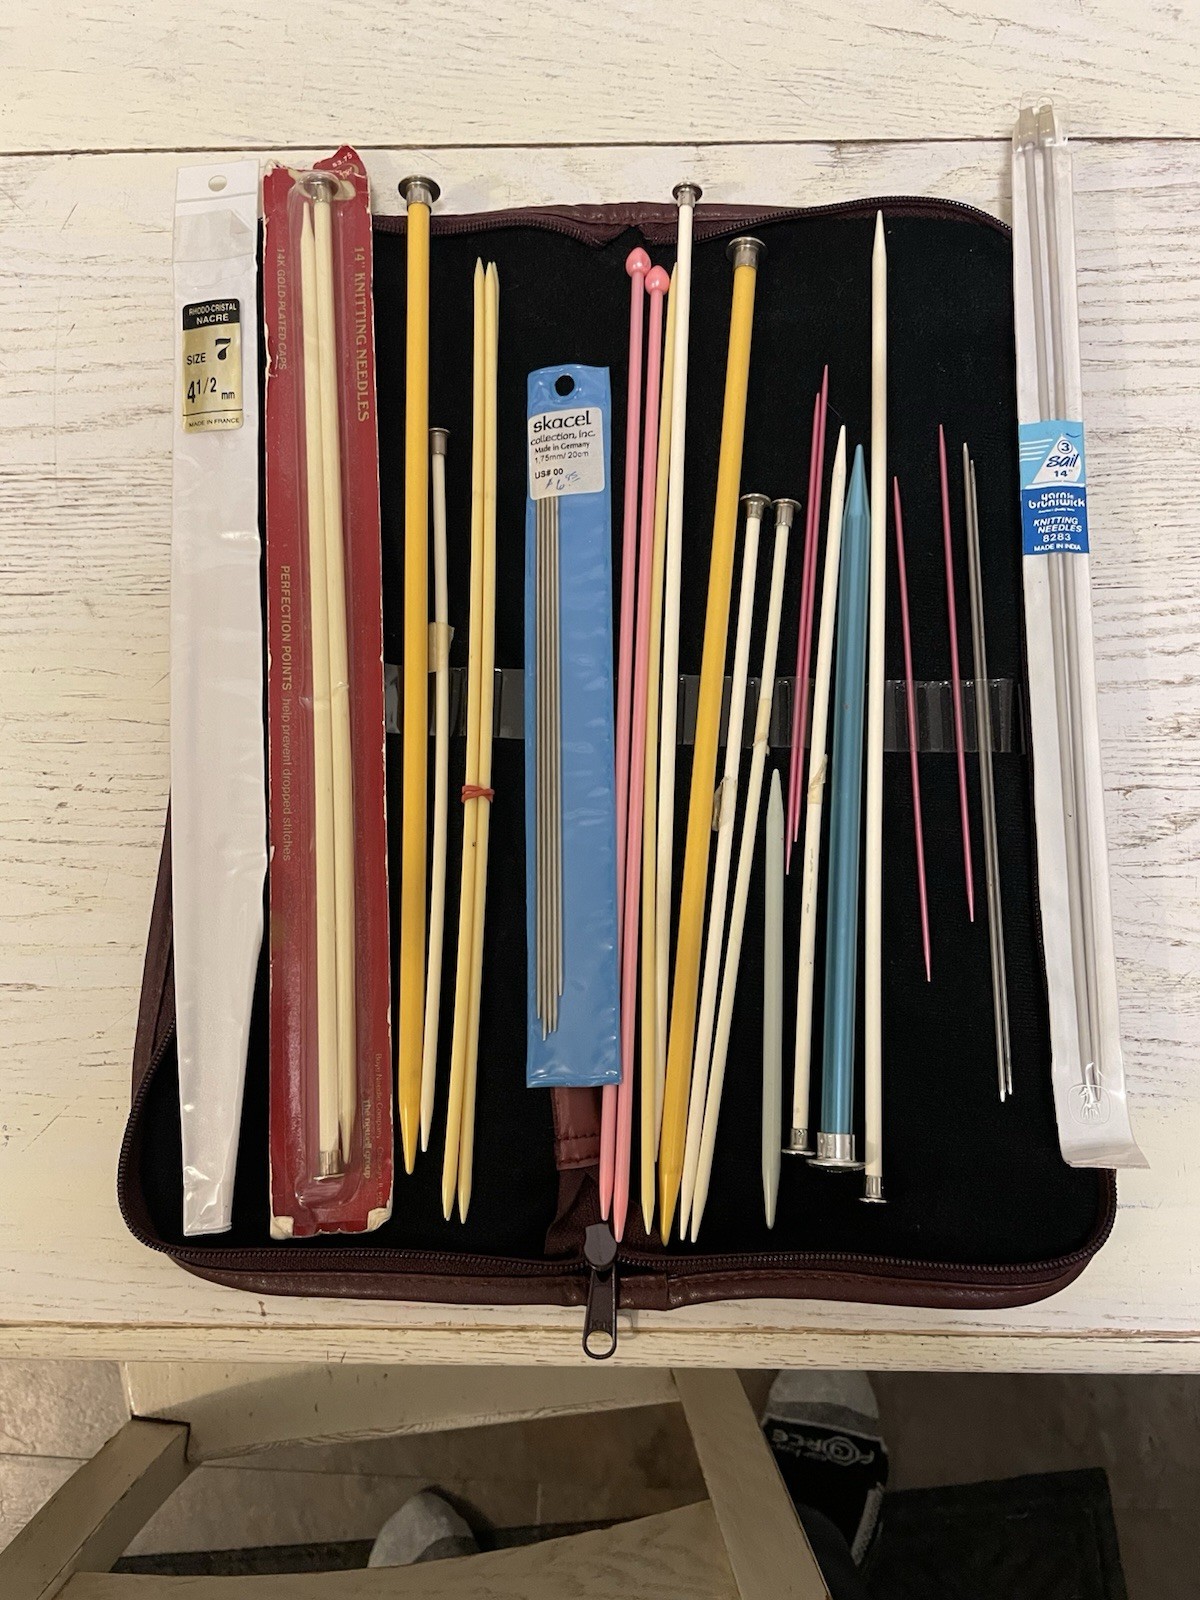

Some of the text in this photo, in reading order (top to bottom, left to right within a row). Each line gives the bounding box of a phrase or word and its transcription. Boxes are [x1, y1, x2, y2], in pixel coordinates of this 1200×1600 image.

[188, 302, 237, 316] RHODO-CRISTAL
[276, 248, 287, 370] 14K GOLD-PLATED CAPS
[354, 272, 368, 345] KNITTING
[196, 313, 229, 325] NACRE
[186, 338, 231, 365] SIZE 7
[356, 349, 370, 422] NEEDLES
[222, 392, 235, 400] mm
[533, 410, 592, 433] skacel
[530, 431, 577, 446] collection,
[534, 444, 551, 454] Made
[561, 442, 590, 450] Germany
[1061, 442, 1069, 452] 3
[568, 451, 589, 459] 20cm
[1046, 454, 1080, 468] sail
[535, 469, 551, 479] US#
[1028, 498, 1085, 509] brunswick
[1033, 516, 1078, 527] KNITTING
[1038, 525, 1082, 534] NEEDLES
[1042, 533, 1072, 542] 8283
[1034, 543, 1054, 551] MADE
[1065, 543, 1081, 551] INDIA
[281, 565, 293, 861] PERFECTION POINTS help prevent dropped stitches
[375, 1102, 384, 1139] Company
[363, 1150, 372, 1179] group
